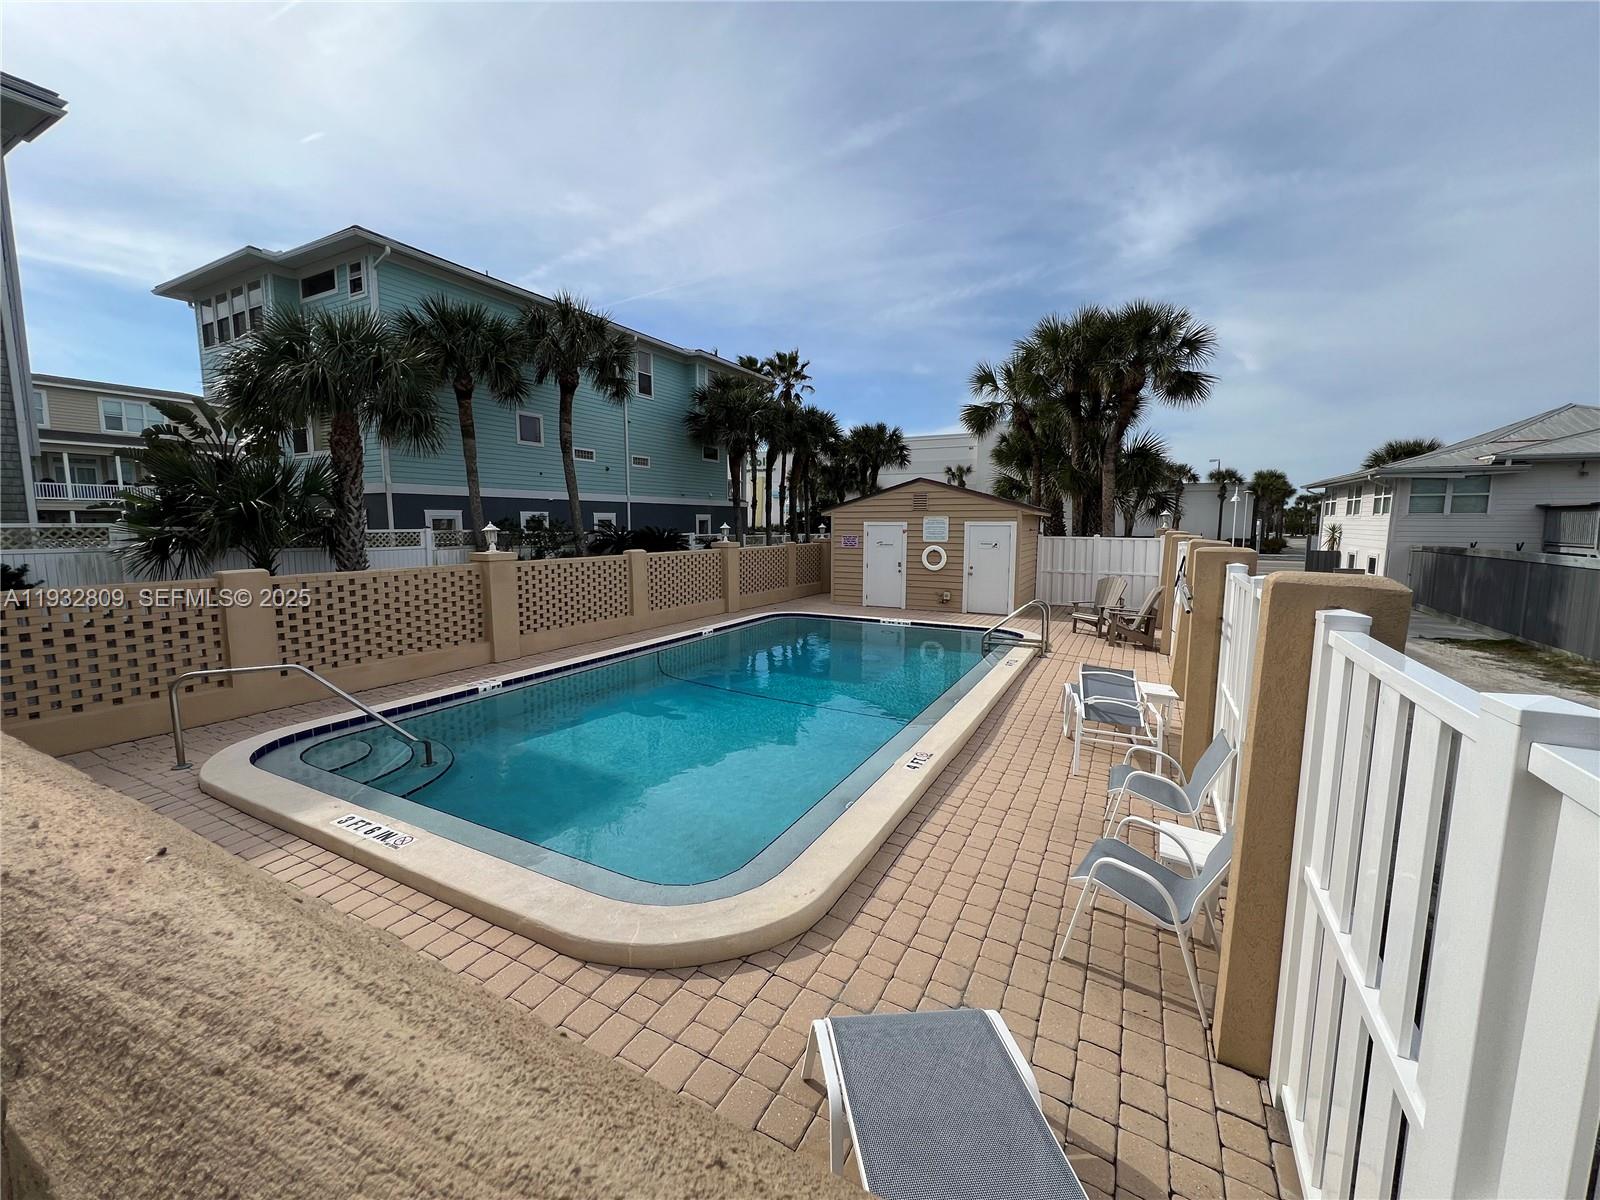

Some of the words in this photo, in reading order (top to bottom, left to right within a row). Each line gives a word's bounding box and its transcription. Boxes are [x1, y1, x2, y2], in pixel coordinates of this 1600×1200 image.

[337, 816, 356, 825] 3
[346, 820, 373, 830] FT
[363, 826, 382, 835] 6
